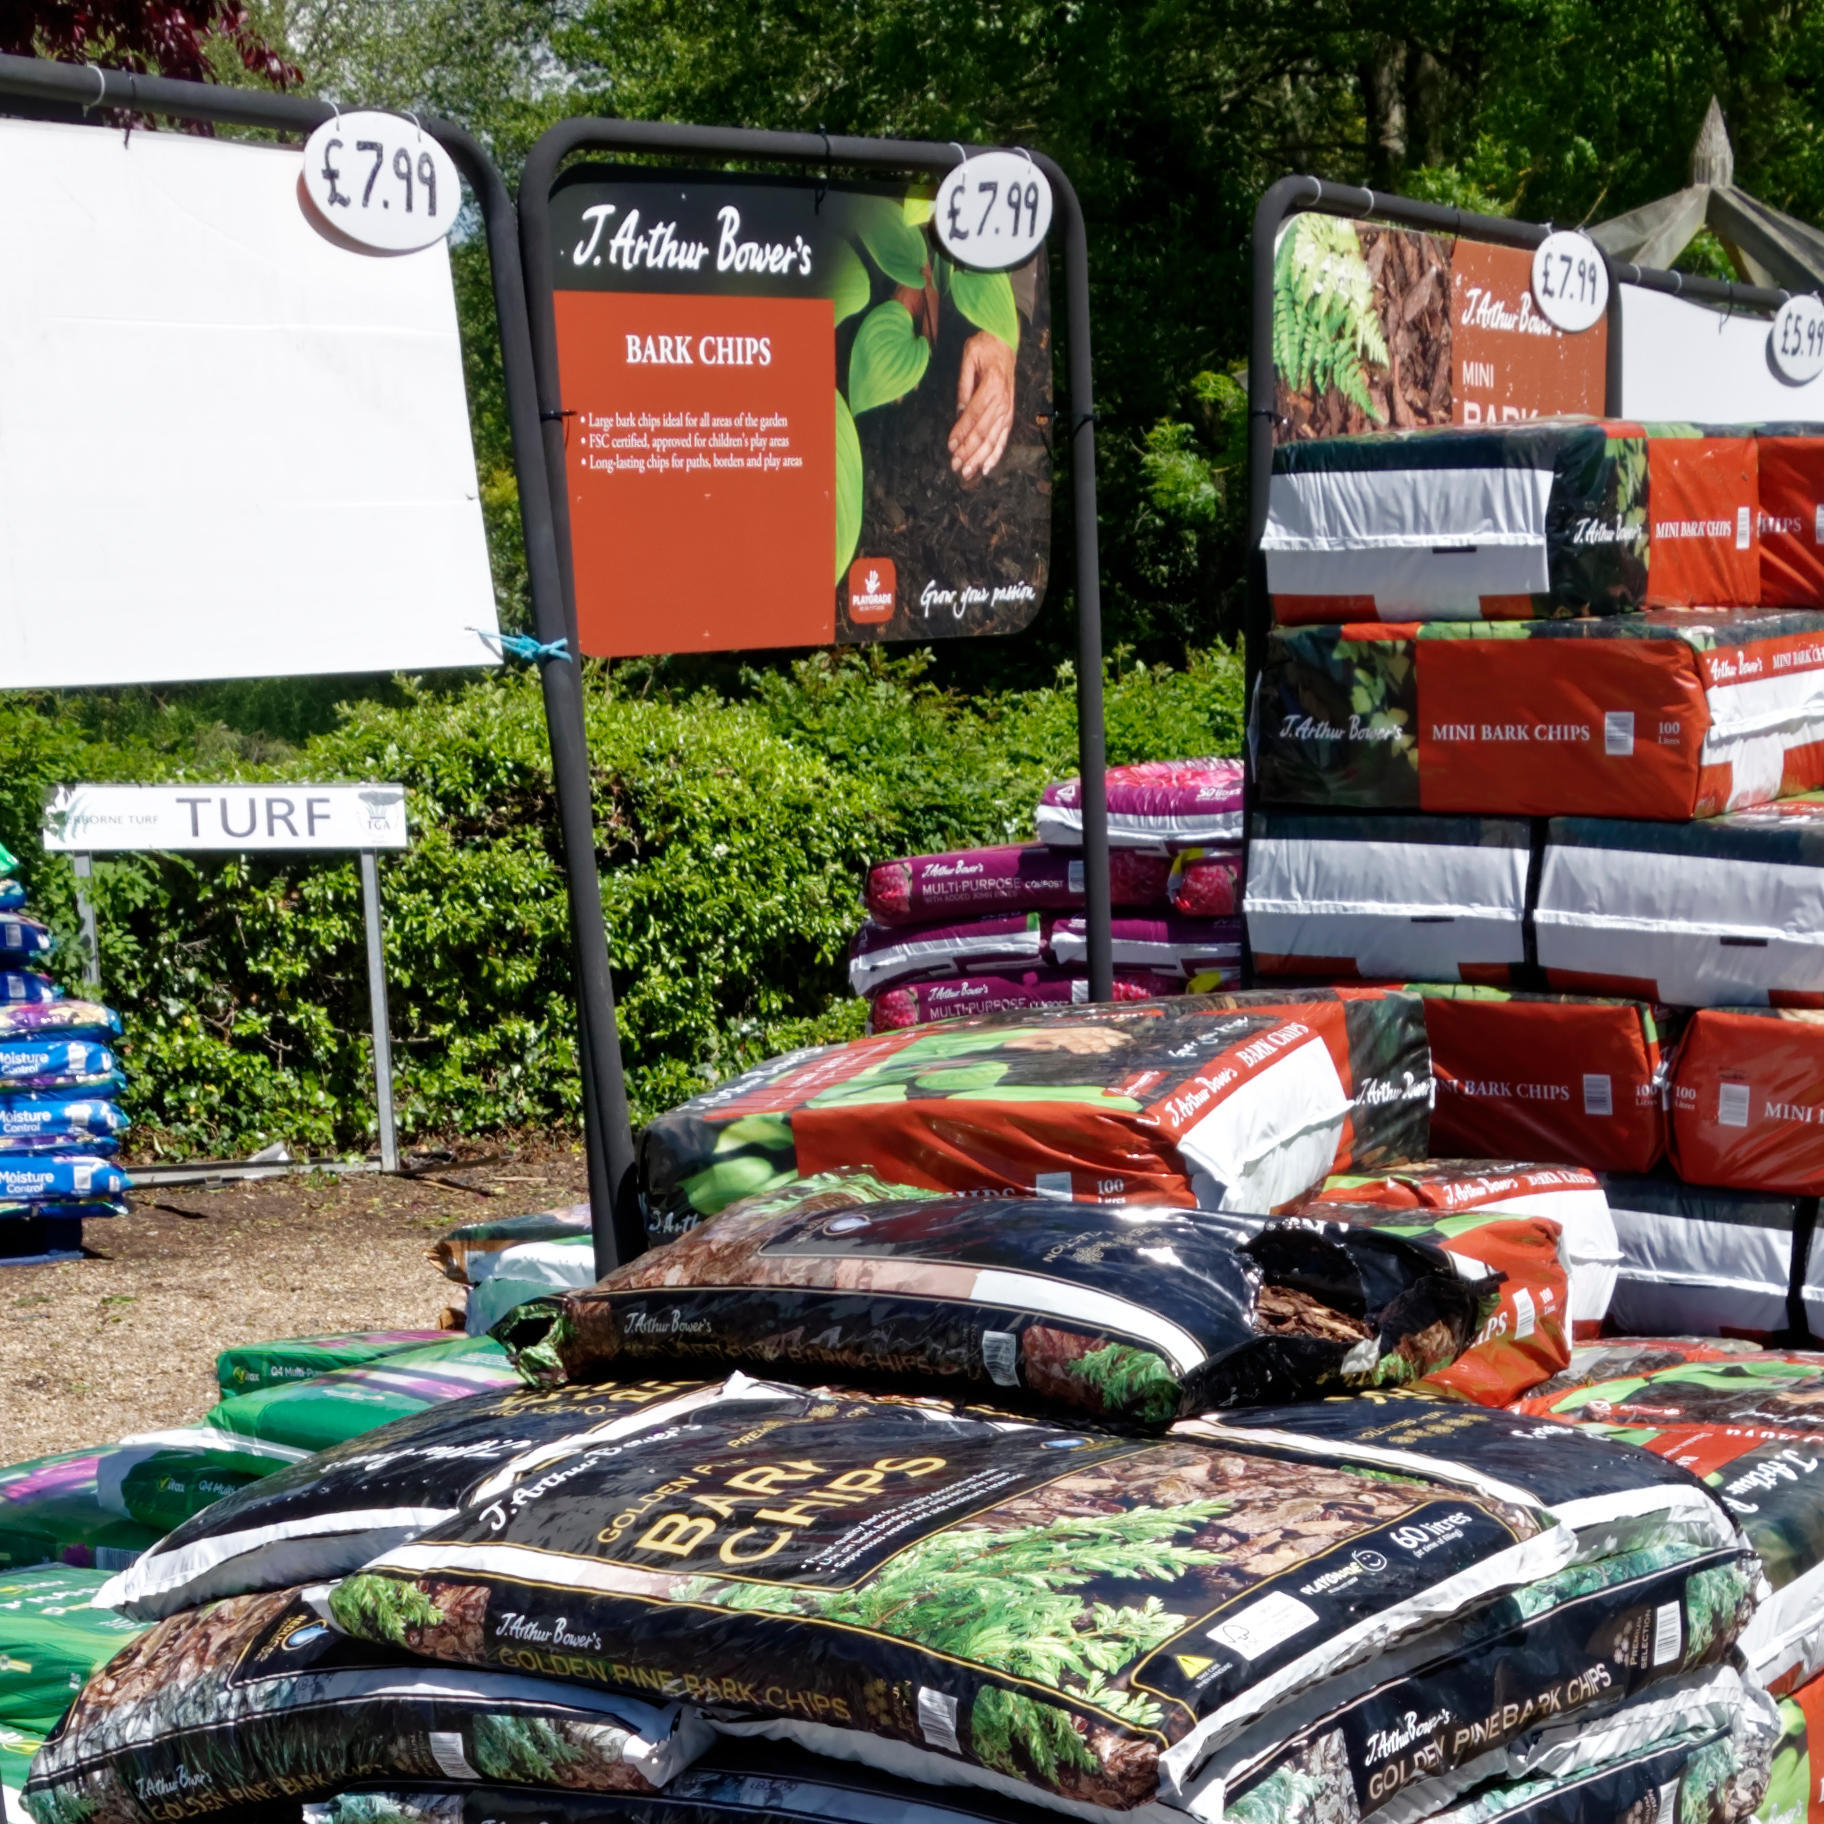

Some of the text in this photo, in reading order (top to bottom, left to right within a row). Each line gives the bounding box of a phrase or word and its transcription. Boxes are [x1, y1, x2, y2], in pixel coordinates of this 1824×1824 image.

[323, 138, 440, 220] £7.99
[948, 182, 1038, 240] £7.99
[716, 205, 812, 276] Bower's
[1542, 252, 1597, 306] £7.99
[626, 334, 772, 366] BARK CHIPS
[1462, 361, 1494, 388] MINI
[588, 412, 787, 430] Large bark chips ideal for all areas of the garden
[589, 434, 789, 451] FSC certified, approved for children's play areas
[590, 454, 802, 472] Long-lasting chips for paths, borders and play areas
[1656, 520, 1731, 538] MINI BARK CHIPS
[921, 580, 1035, 618] Grow your passion
[1349, 714, 1403, 743] Bower's
[1433, 724, 1590, 742] MINI BARK CHIPS
[1658, 722, 1680, 735] 100
[128, 815, 159, 825] TURF
[176, 798, 331, 838] TURF
[367, 820, 391, 830] TGA
[955, 860, 983, 875] Bower's
[961, 982, 988, 997] Bower's
[1, 1064, 39, 1074] Control
[1465, 1081, 1569, 1100] BARK CHIPS
[1675, 1087, 1697, 1100] 100
[1765, 1101, 1814, 1123] MINI
[6, 1183, 44, 1193] Control
[597, 1423, 703, 1457] Bower's
[597, 1476, 698, 1544] GOLDEN
[719, 1456, 948, 1565] CHIPS
[1390, 1524, 1428, 1549] 60
[1422, 1512, 1472, 1538] litres
[553, 1617, 602, 1650] Bower's
[1641, 1609, 1652, 1669] SELECTION
[499, 1647, 852, 1720] GOLDEN PINE BARK CHIPS
[1370, 1663, 1612, 1800] GOLDEN PINE BARK CHIPS
